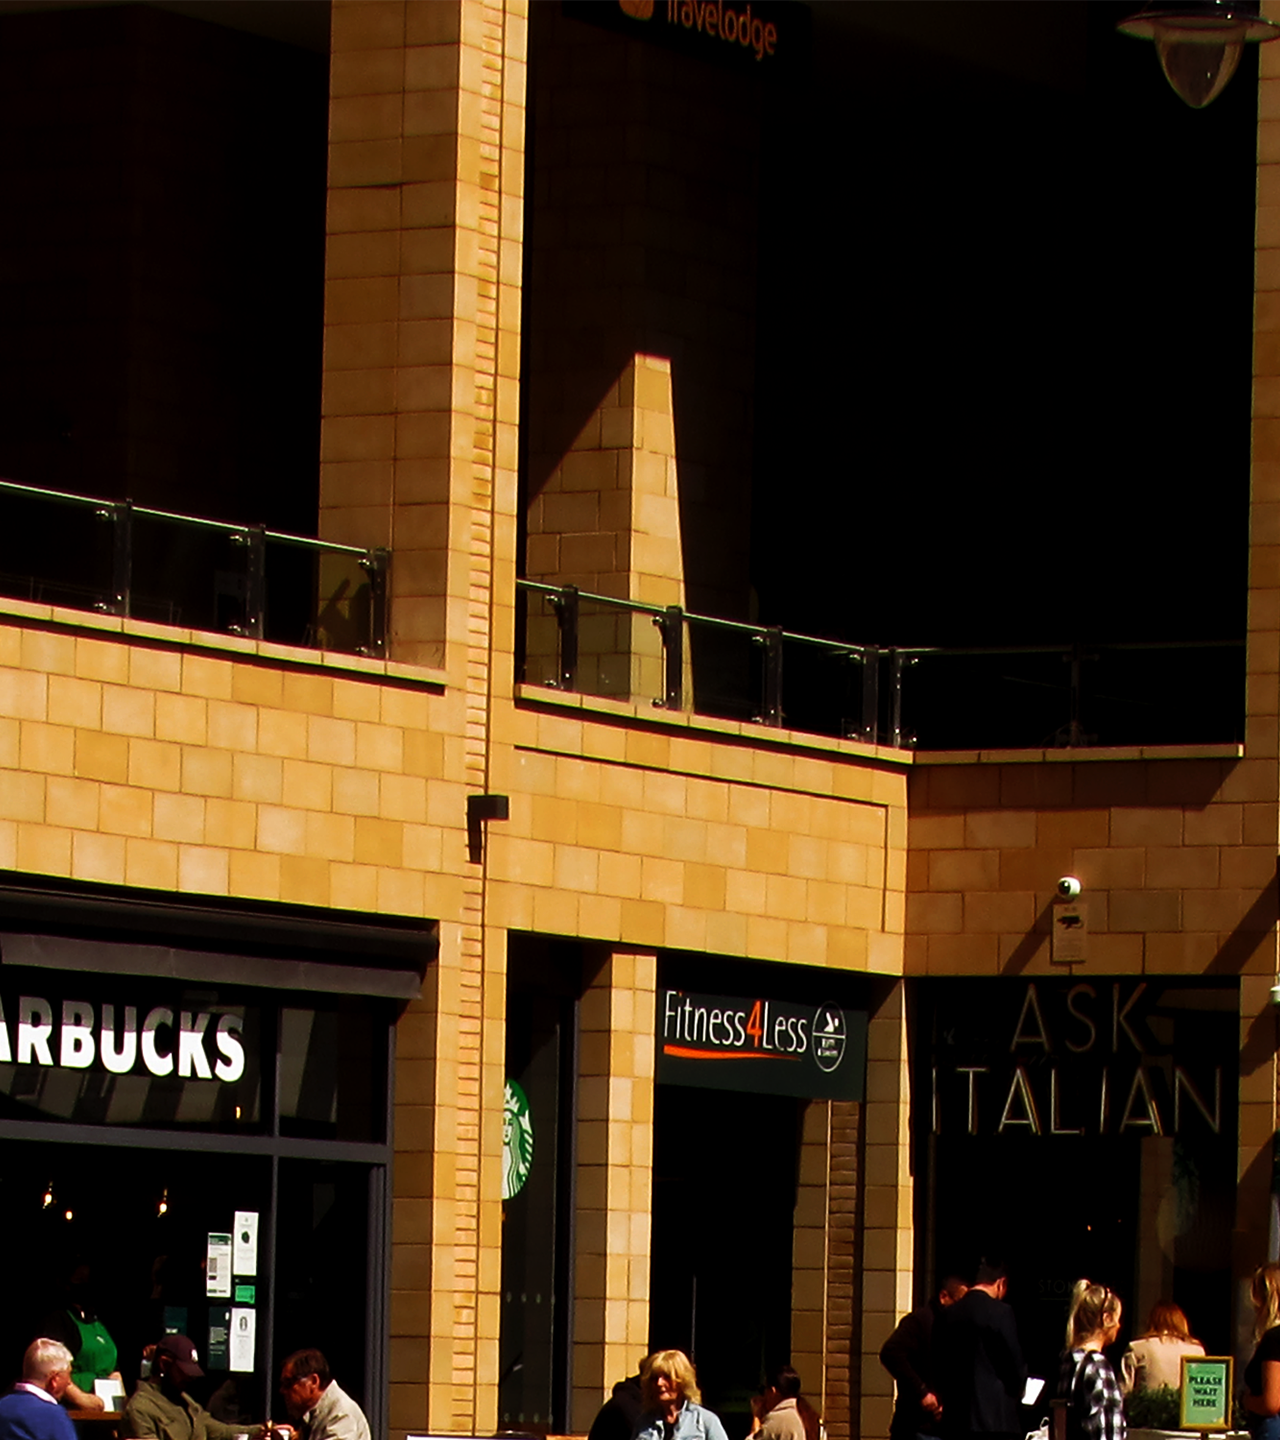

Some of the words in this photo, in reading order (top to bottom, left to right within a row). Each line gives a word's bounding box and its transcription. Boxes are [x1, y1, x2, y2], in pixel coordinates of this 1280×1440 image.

[663, 989, 808, 1054] Fitness4Less
[1008, 982, 1148, 1054] ASK
[929, 1064, 1222, 1136] ITALIAN
[1188, 1376, 1222, 1386] PLEASE
[1192, 1387, 1217, 1396] WAIT
[1192, 1398, 1218, 1408] HERE
